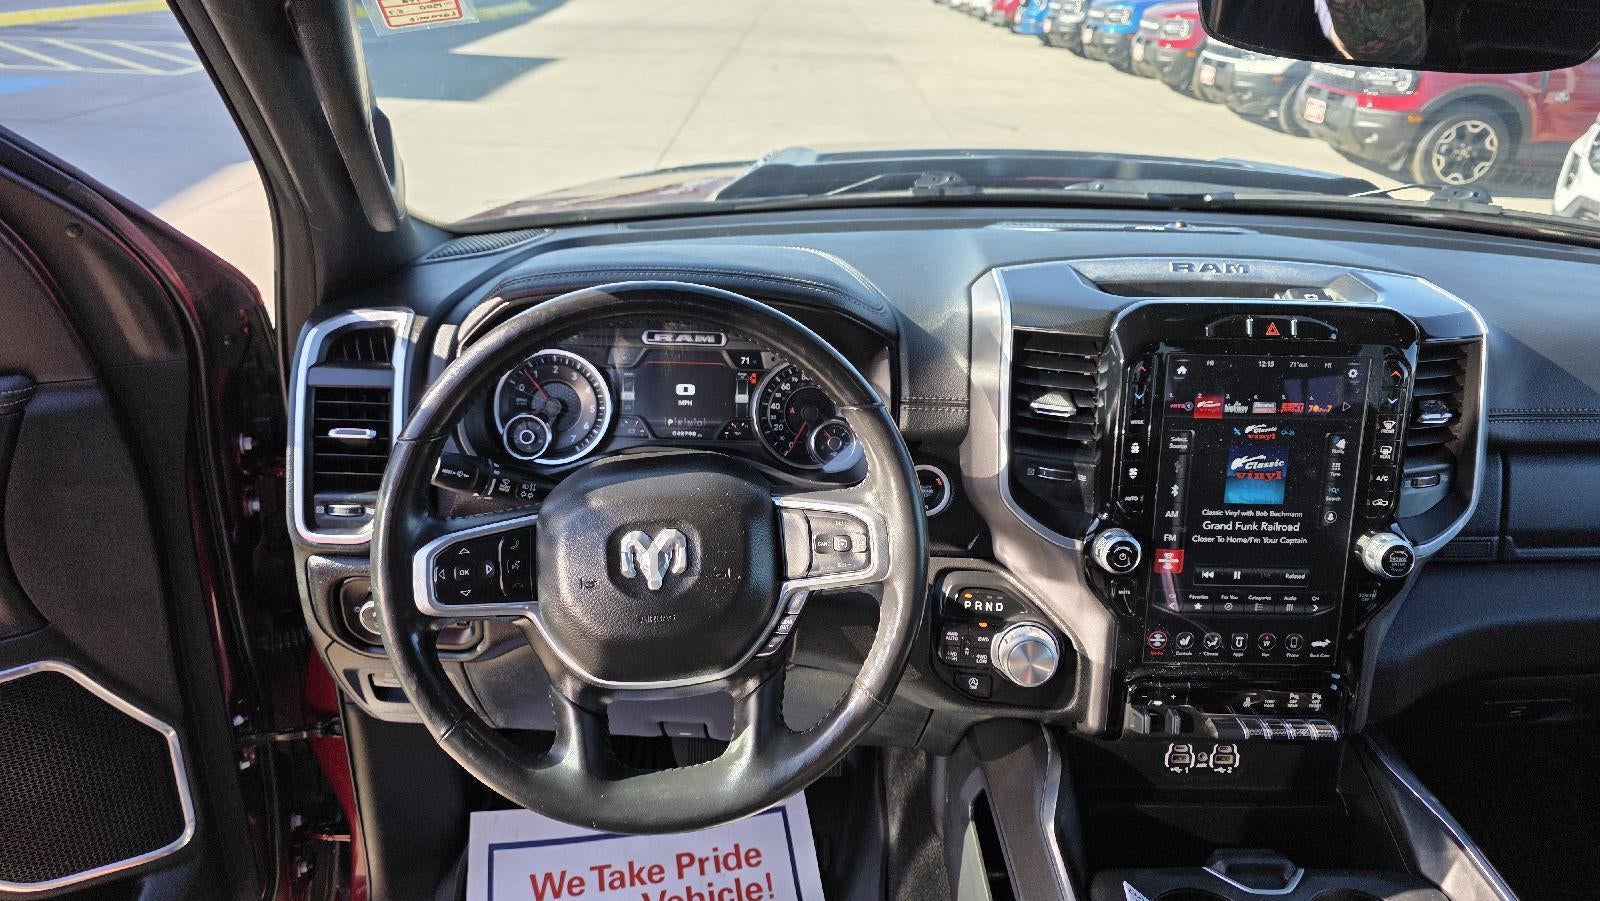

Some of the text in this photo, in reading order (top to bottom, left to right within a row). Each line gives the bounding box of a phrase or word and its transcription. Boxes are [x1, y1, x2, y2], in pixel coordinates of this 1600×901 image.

[1169, 261, 1249, 274] RAM
[653, 333, 716, 343] RAM
[740, 356, 750, 365] 71
[675, 383, 696, 396] 0
[780, 382, 791, 391] 60
[770, 402, 781, 410] 40
[773, 423, 784, 431] 20
[1244, 457, 1285, 470] Classic
[1235, 469, 1283, 481] vinyl
[1164, 510, 1179, 518] AM
[1201, 508, 1224, 516] Classic
[1224, 509, 1240, 518] Vinyl
[1202, 520, 1301, 532] Grand Funk Railroad
[1163, 534, 1177, 542] FM
[1191, 534, 1216, 543] Closer
[1216, 535, 1225, 543] To
[1262, 536, 1279, 544] Your
[1279, 536, 1308, 545] Captain
[974, 600, 983, 611] R
[985, 601, 993, 612] N
[995, 602, 1004, 612] D
[530, 844, 763, 901] We Take Pride
